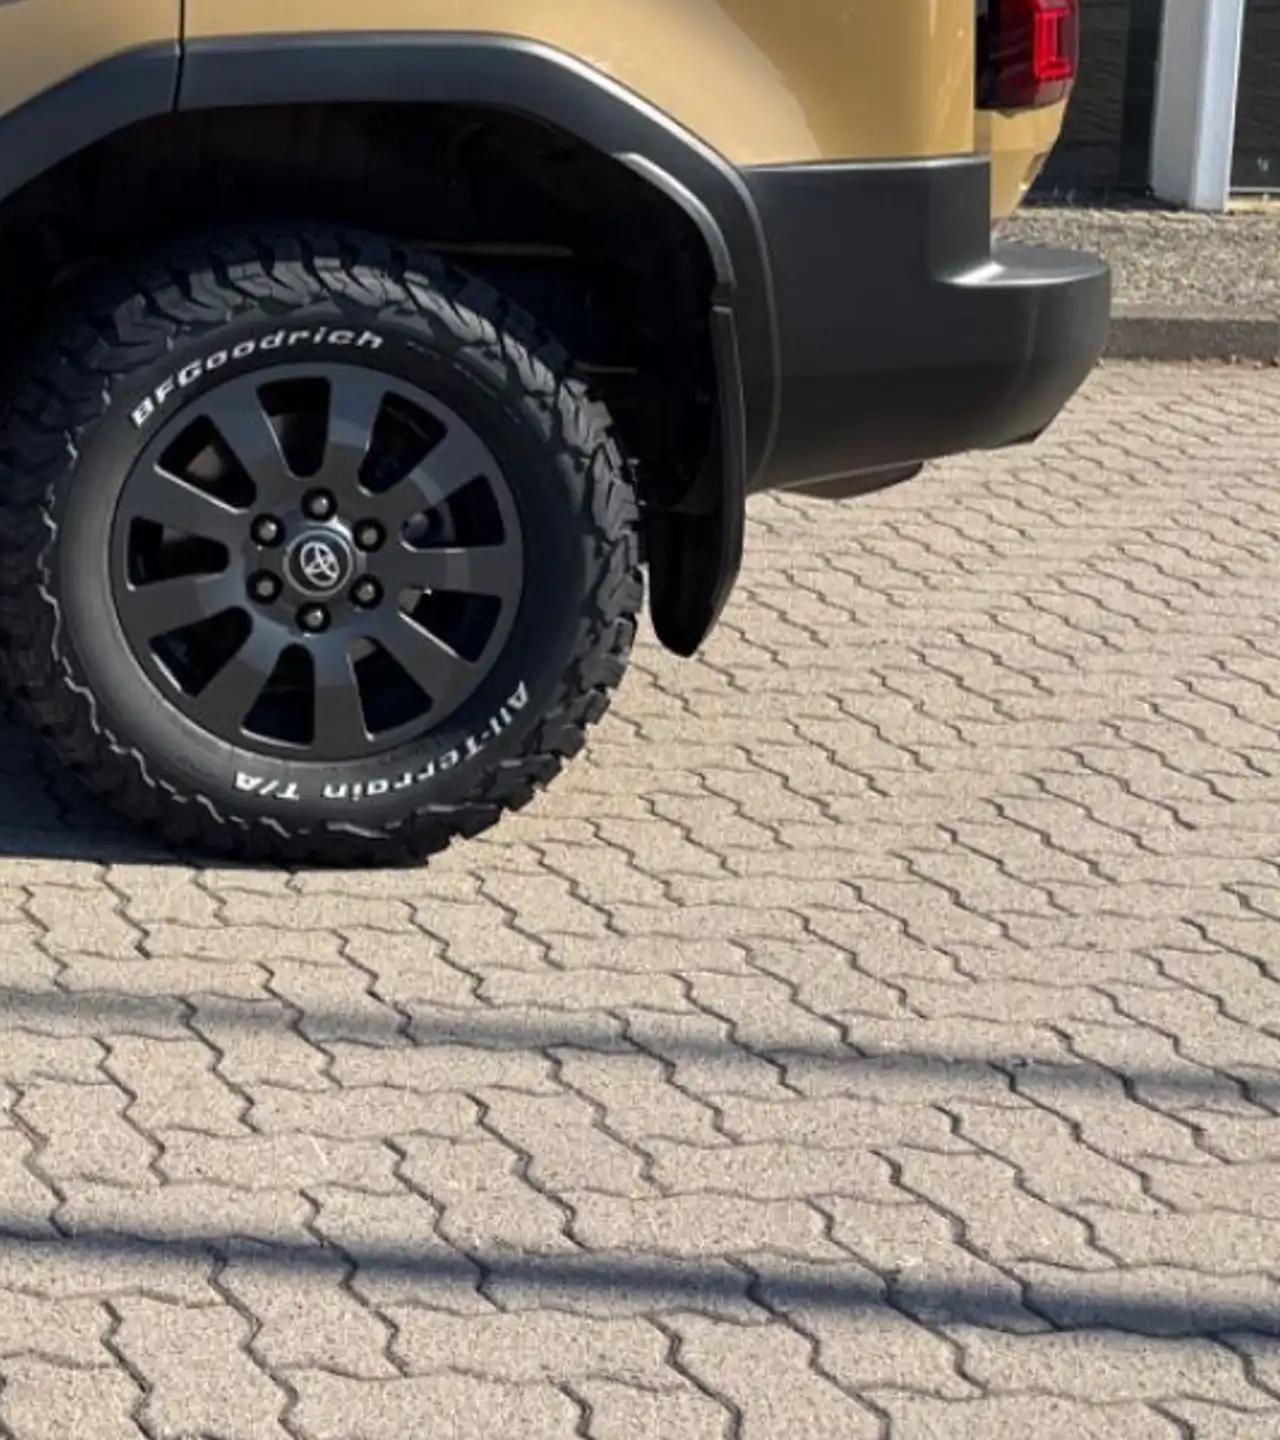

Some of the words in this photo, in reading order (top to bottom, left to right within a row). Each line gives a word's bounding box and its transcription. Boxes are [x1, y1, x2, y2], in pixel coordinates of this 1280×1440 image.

[130, 326, 385, 428] BFGoodrich
[234, 770, 301, 802] T/A
[321, 680, 531, 800] All-Terrain
